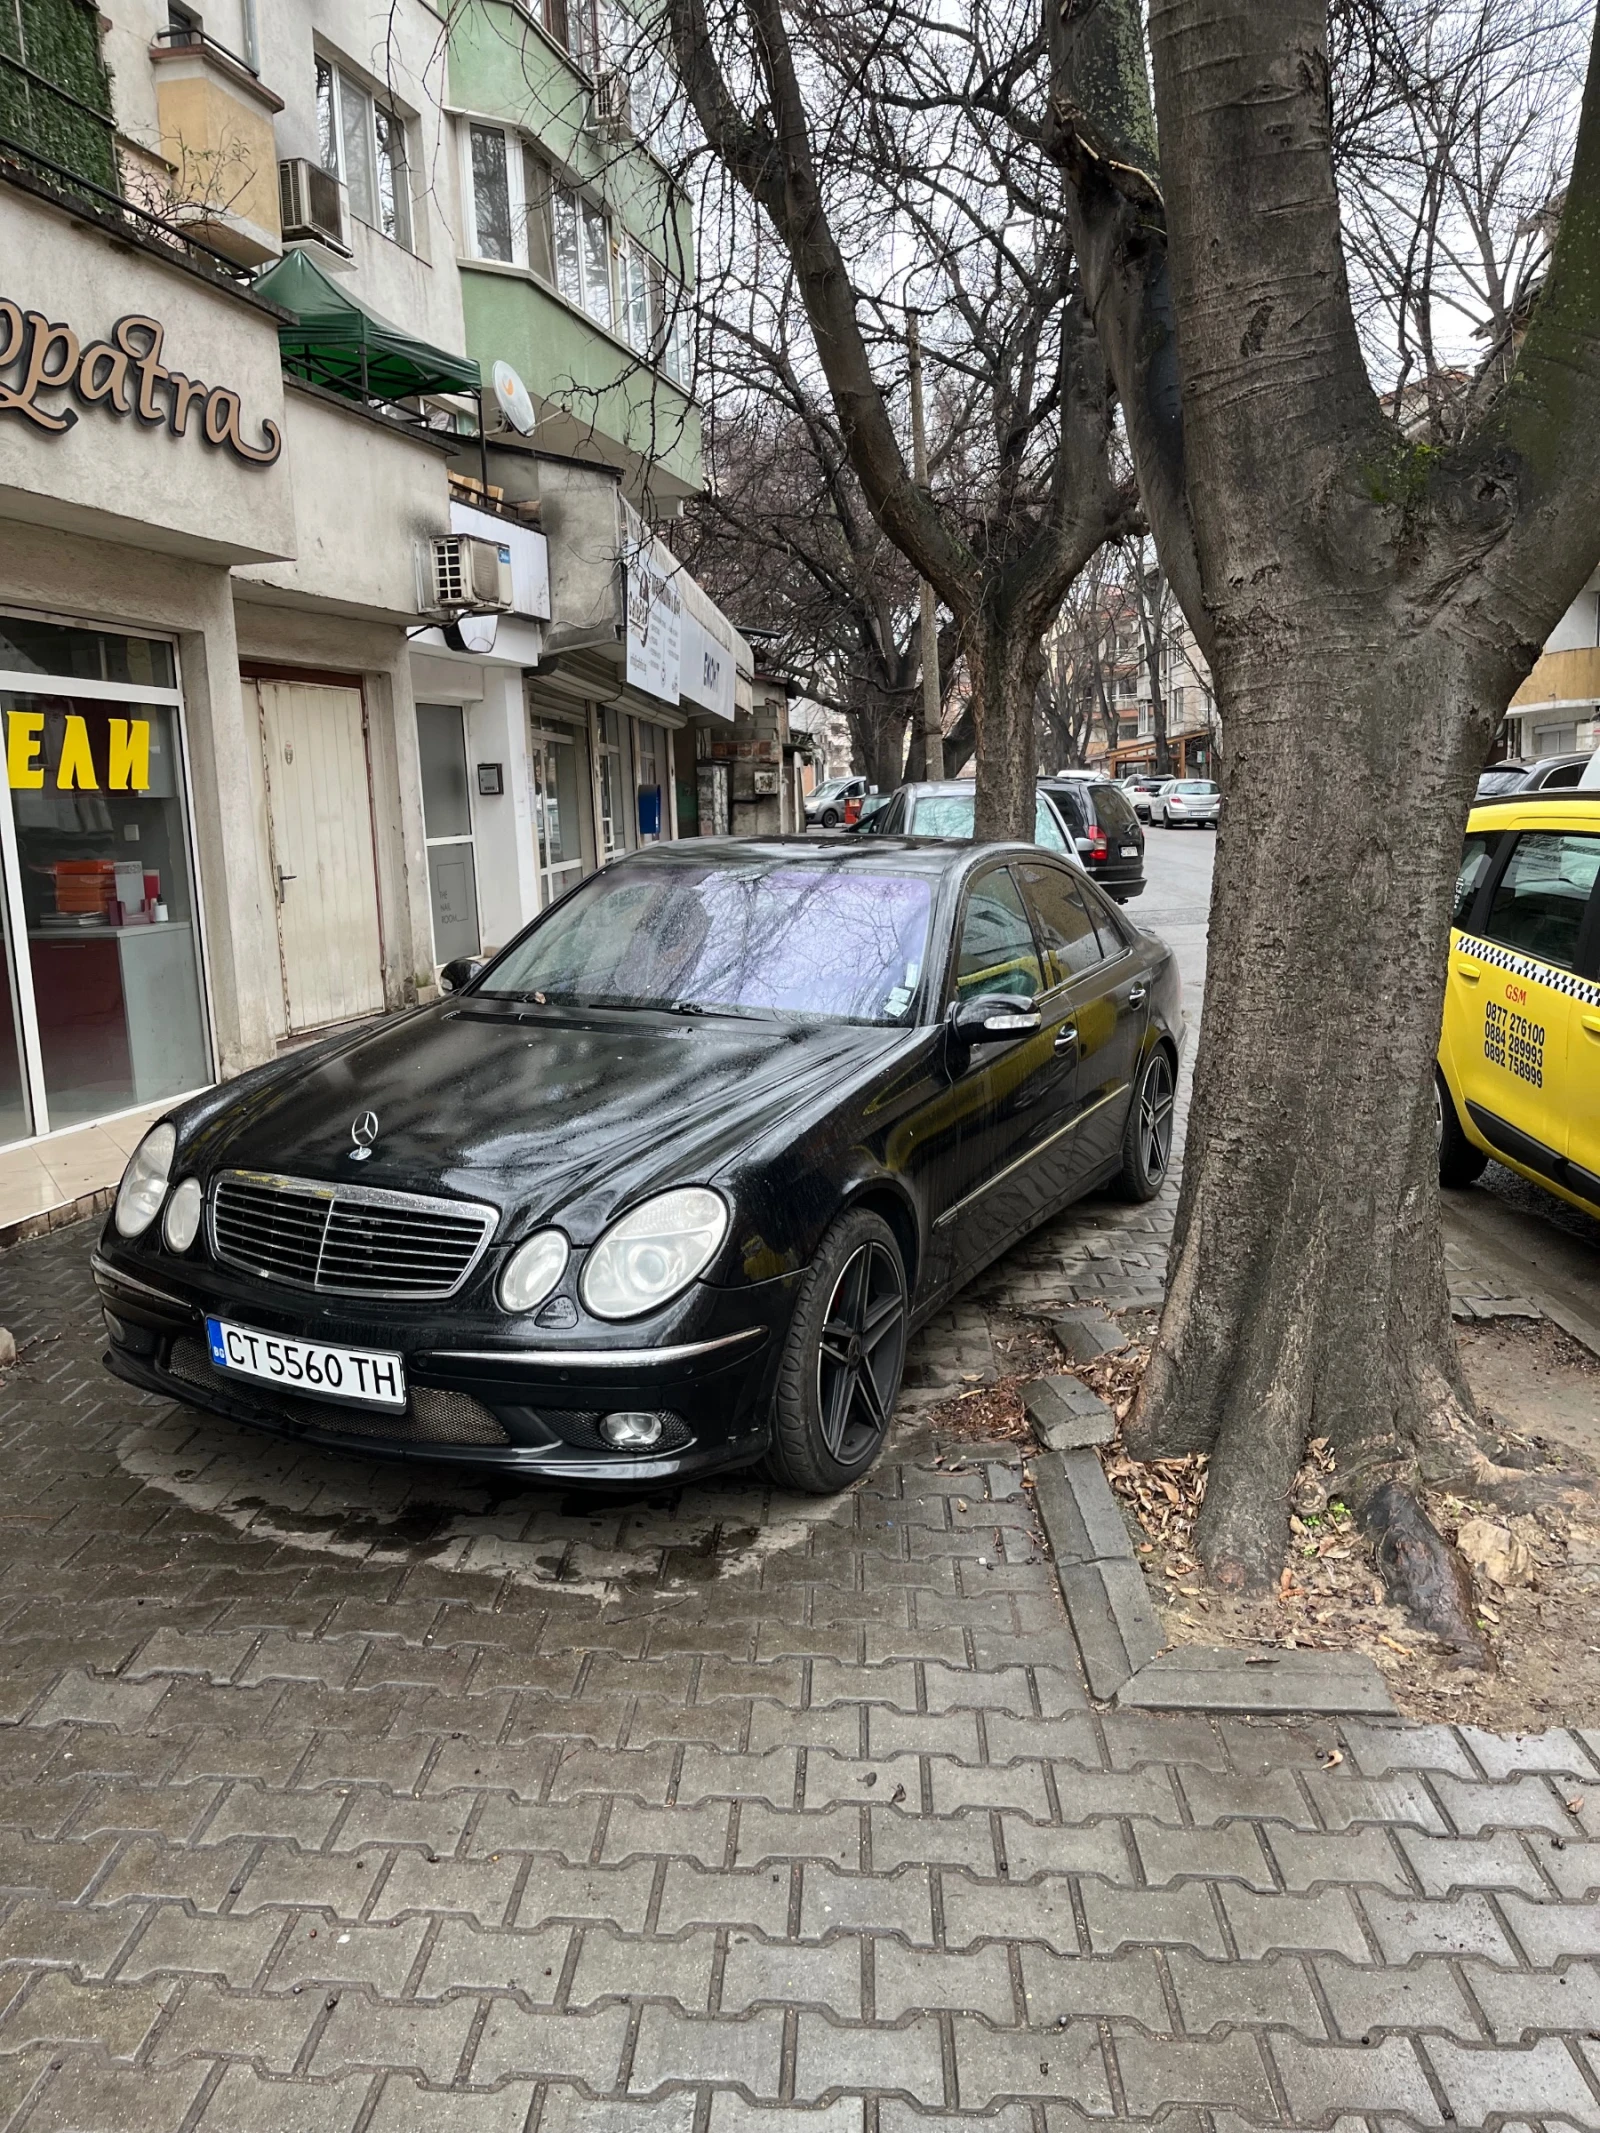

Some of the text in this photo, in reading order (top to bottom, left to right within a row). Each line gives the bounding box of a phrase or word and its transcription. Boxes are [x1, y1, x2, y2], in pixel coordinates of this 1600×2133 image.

[1505, 984, 1527, 1006] GSM
[1484, 1020, 1543, 1068] 0884 289993
[1486, 1000, 1545, 1047] 0877 276100
[1484, 1041, 1543, 1089] 0892 758999
[213, 1346, 226, 1359] BG
[266, 1341, 343, 1388] 5560
